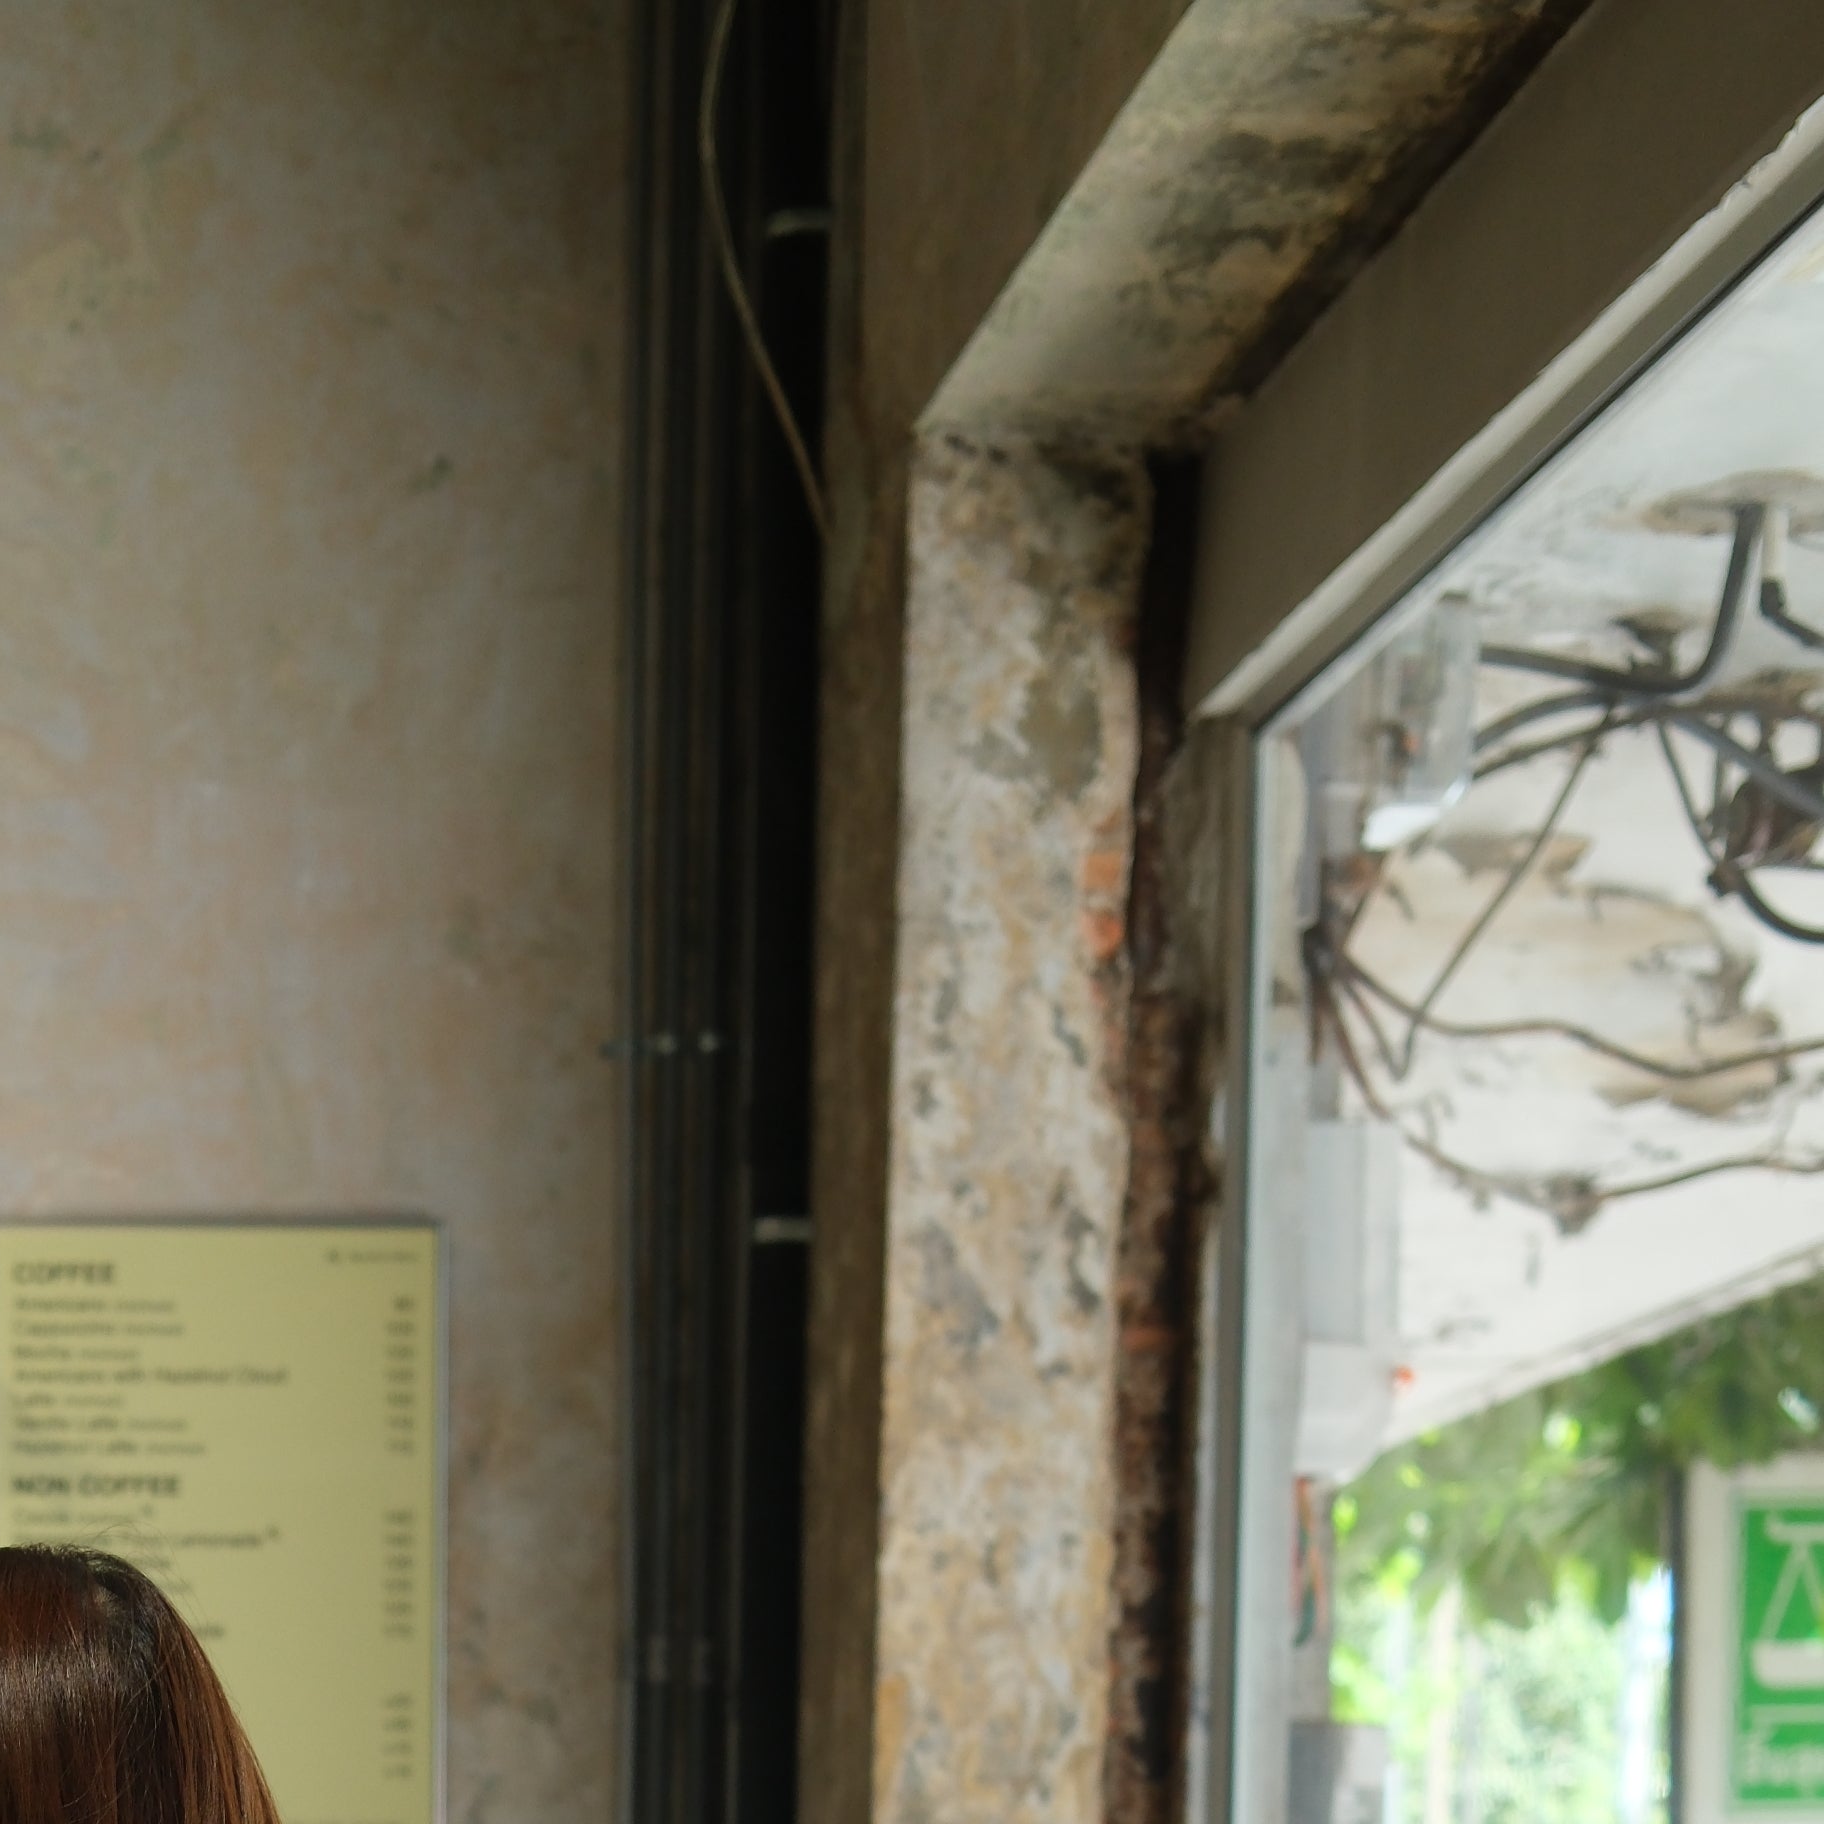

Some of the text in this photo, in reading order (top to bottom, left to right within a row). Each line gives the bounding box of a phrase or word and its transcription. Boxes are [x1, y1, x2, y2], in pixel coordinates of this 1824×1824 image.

[12, 1262, 114, 1285] COFFEE
[12, 1475, 180, 1496] NON COFFEE
